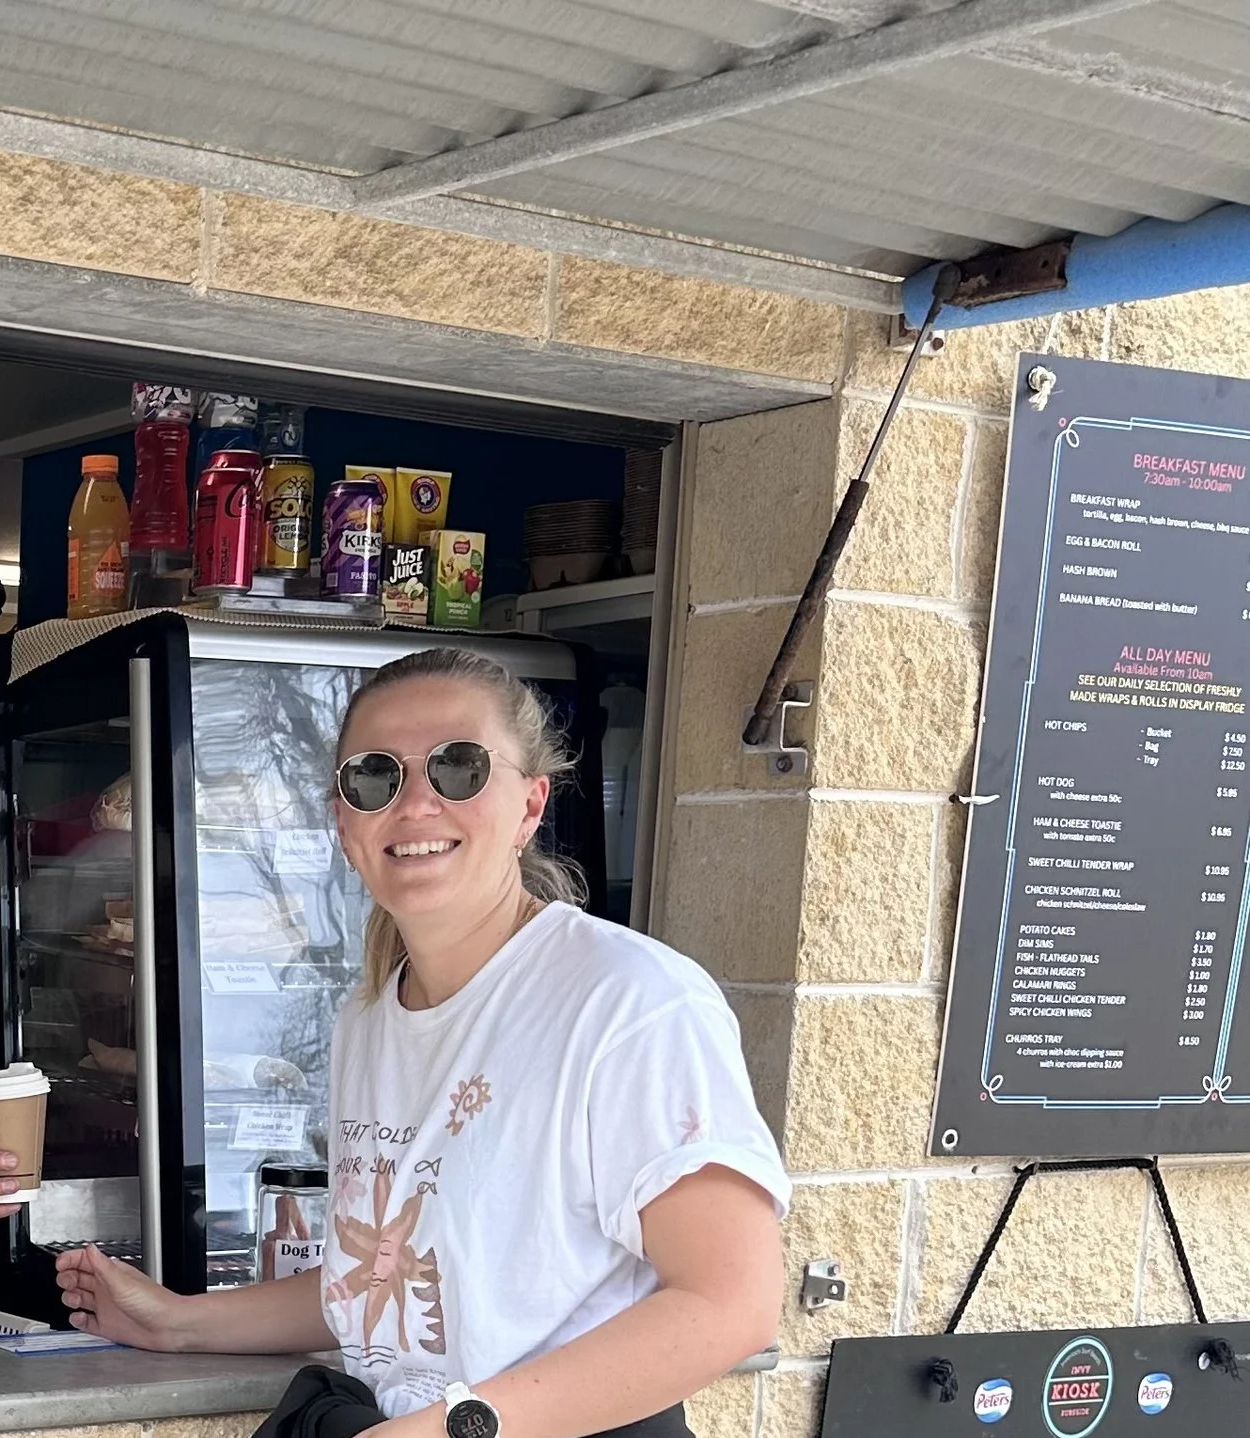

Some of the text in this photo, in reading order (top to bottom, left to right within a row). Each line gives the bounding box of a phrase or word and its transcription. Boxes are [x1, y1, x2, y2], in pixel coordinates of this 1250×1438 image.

[1134, 454, 1246, 479] BREAKFAST MENU
[1143, 472, 1232, 492] 7:30am 10:00am
[1071, 494, 1141, 509] BREAKFAST WRAP
[1066, 535, 1141, 552] EGG & BACON ROLL
[392, 548, 424, 566] JUST
[390, 561, 424, 583] JUICE
[1063, 564, 1117, 578] HASH BROWN
[1060, 593, 1093, 605] BANANA
[1095, 596, 1121, 607] BREAD
[1155, 601, 1170, 611] with
[1120, 646, 1210, 666] ALL DAY MENU
[1114, 662, 1214, 680] Available From 10am
[1078, 674, 1243, 698] SEE OUR DAILY SELECTION OF FRESHLY
[1069, 691, 1097, 703] MADE
[1099, 692, 1130, 705] WRAPS
[1139, 695, 1167, 708] ROLLS
[1169, 697, 1178, 709] IN
[1179, 699, 1214, 712] DISPLAY
[1215, 701, 1245, 714] FRIDGE
[1045, 721, 1062, 730] HOT
[1064, 721, 1087, 732] CHIPS
[1145, 741, 1159, 753] Bag
[1143, 755, 1159, 766] Tray
[1038, 777, 1075, 787] HOT DOG
[1034, 817, 1052, 826] HAM
[1060, 818, 1090, 829] CHEESE
[1091, 820, 1122, 830] TOASTIE
[1028, 857, 1135, 871] SWEET CHILLI TENDER WRAP
[1025, 885, 1121, 898] CHICKEN SCHNITZEL ROLL
[1020, 925, 1076, 936] POTATO CAKES
[1018, 939, 1054, 949] DIM SIMS
[1016, 953, 1100, 964] FISH FLATHEAD TAILS
[1015, 966, 1086, 977] CHICKEN NUGGETS
[1013, 980, 1077, 990] CALAMARI RINGS
[1011, 993, 1126, 1005] SWEET CHILLI CHICKEN TENDER
[1009, 1007, 1092, 1018] SPICY CHICKEN WINGS
[1006, 1035, 1063, 1044] CHURROS TRAY
[339, 1120, 370, 1143] THAT
[281, 1244, 310, 1259] Dog
[1051, 1382, 1101, 1400] KIOSK
[1140, 1384, 1173, 1403] Peters
[977, 1393, 1009, 1408] Peters
